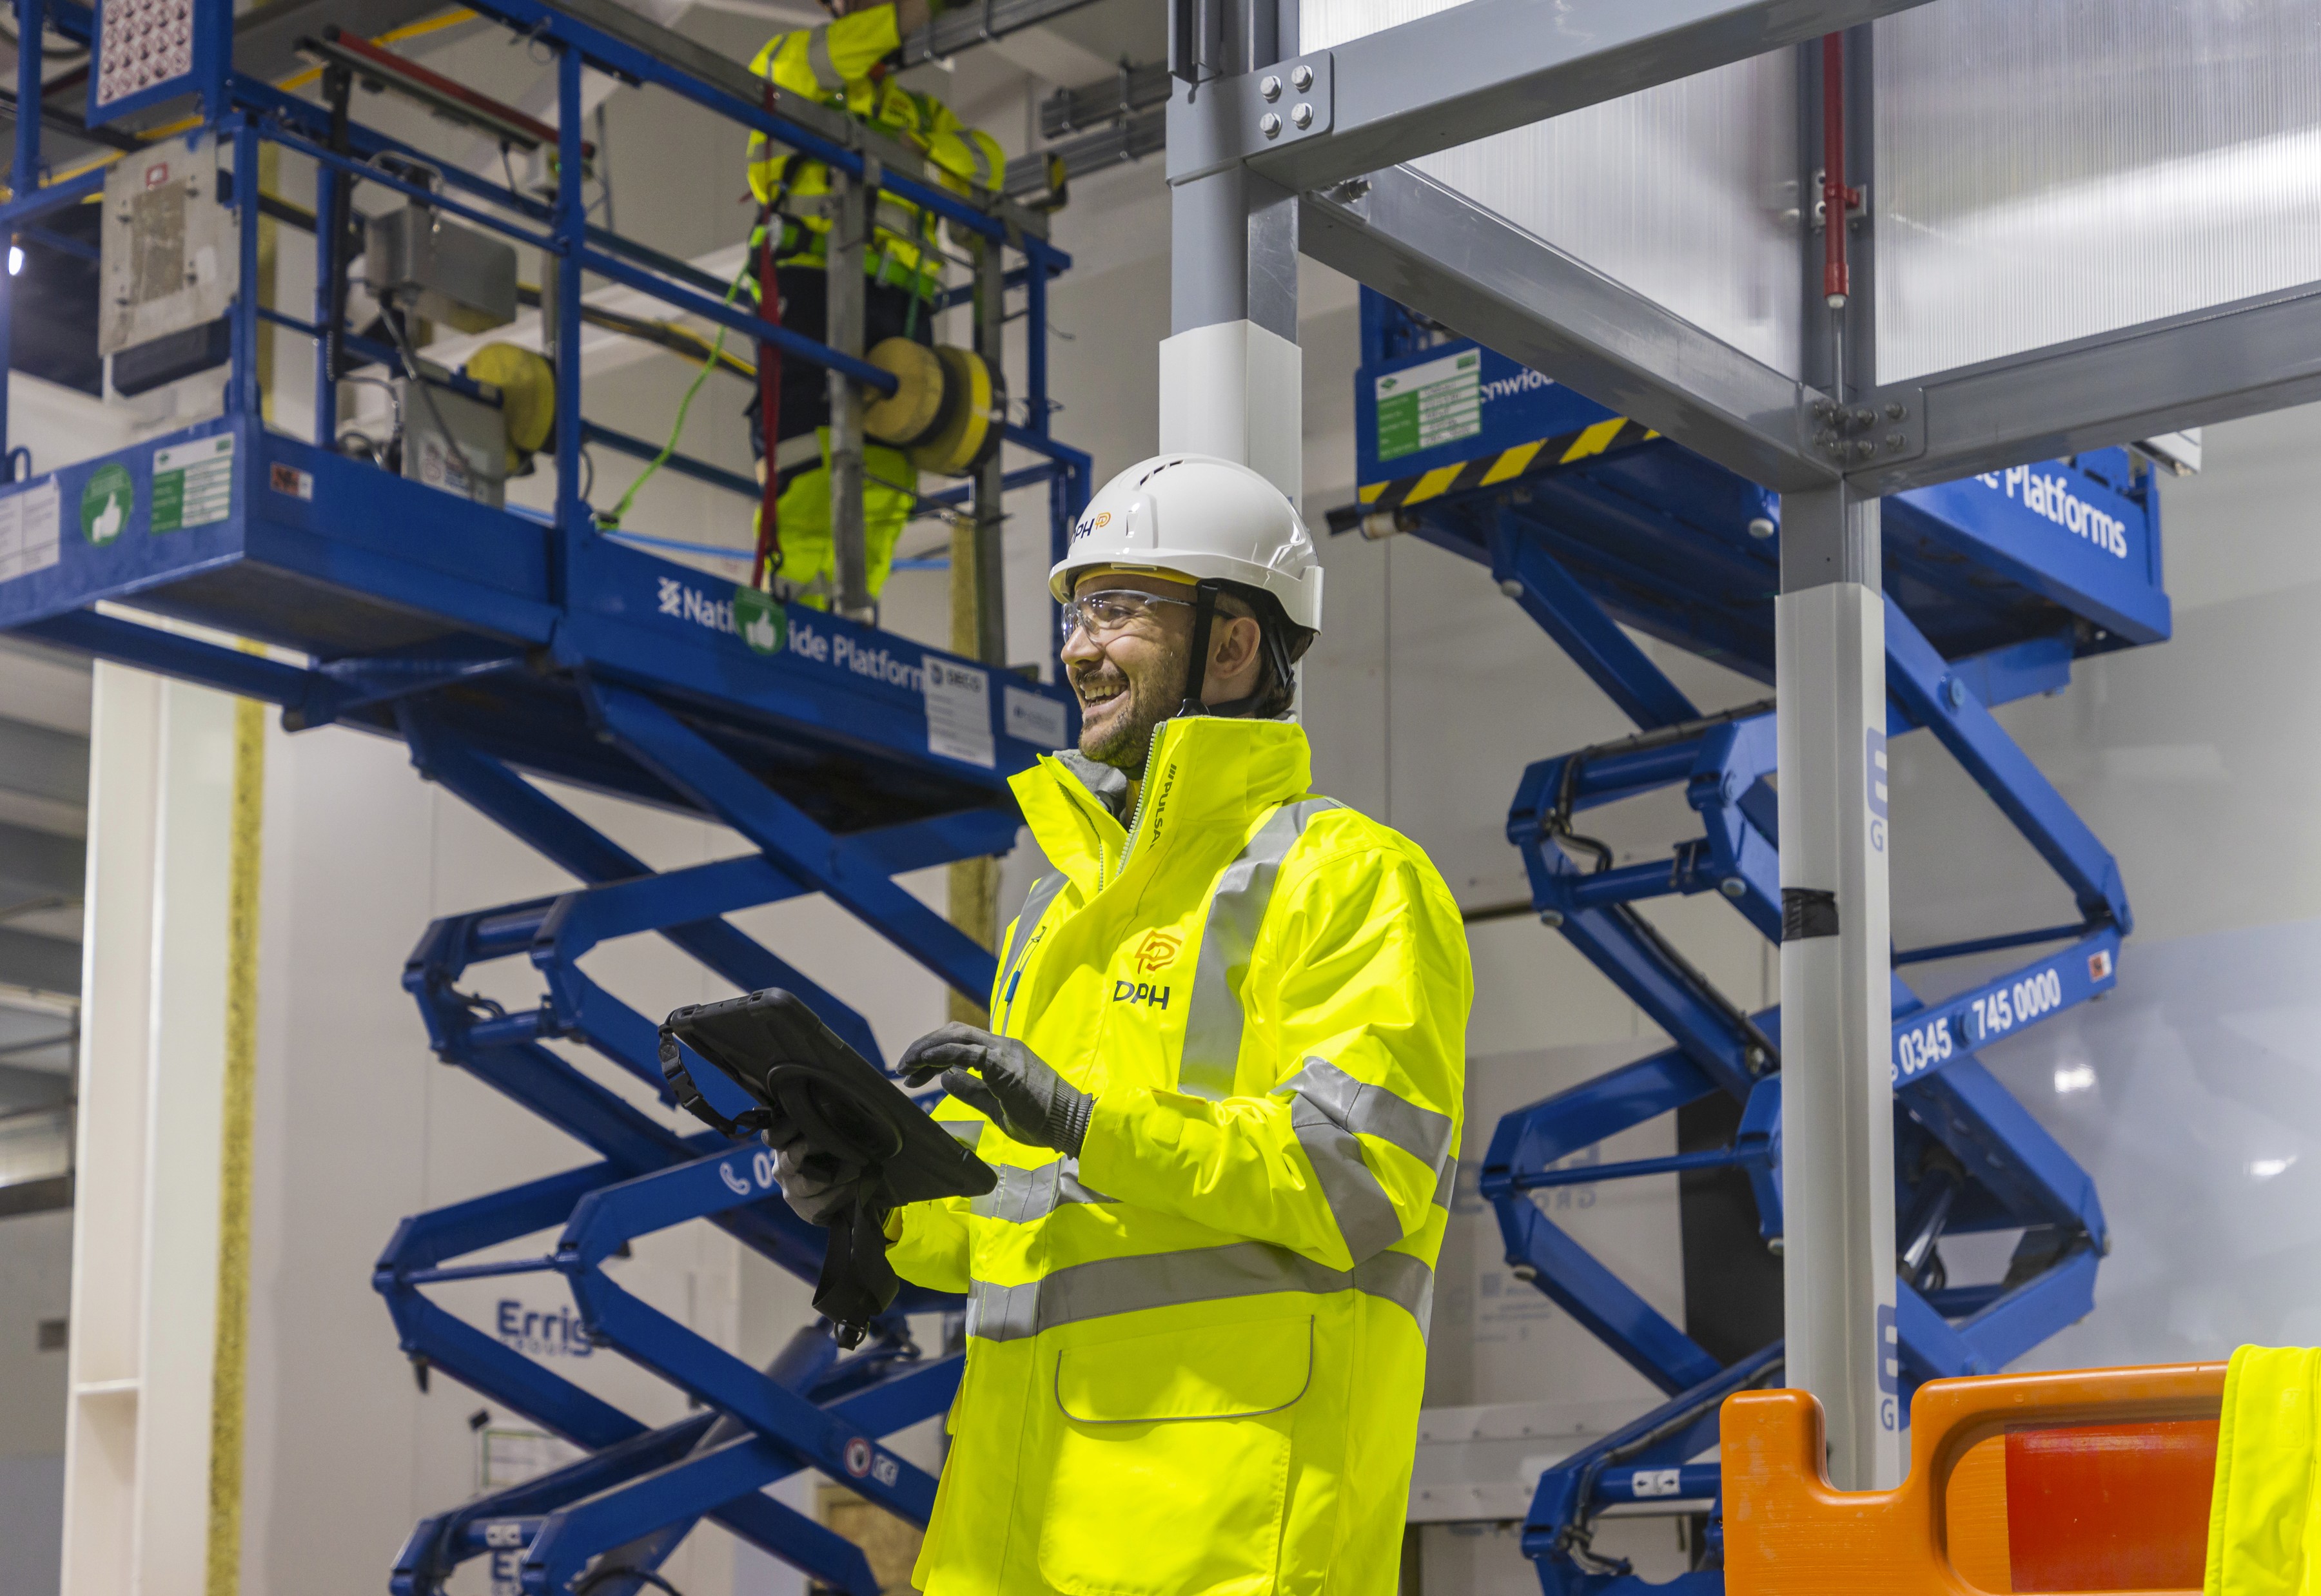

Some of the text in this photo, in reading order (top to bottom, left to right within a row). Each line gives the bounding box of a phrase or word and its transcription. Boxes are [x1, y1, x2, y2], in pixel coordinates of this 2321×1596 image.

[1070, 518, 1095, 545] PH
[2005, 464, 2128, 559] Platforms
[833, 633, 925, 692] Platform
[1113, 980, 1170, 1010] DPH
[1899, 968, 2062, 1076] 0345 745 0000
[496, 1299, 594, 1357] Erris
